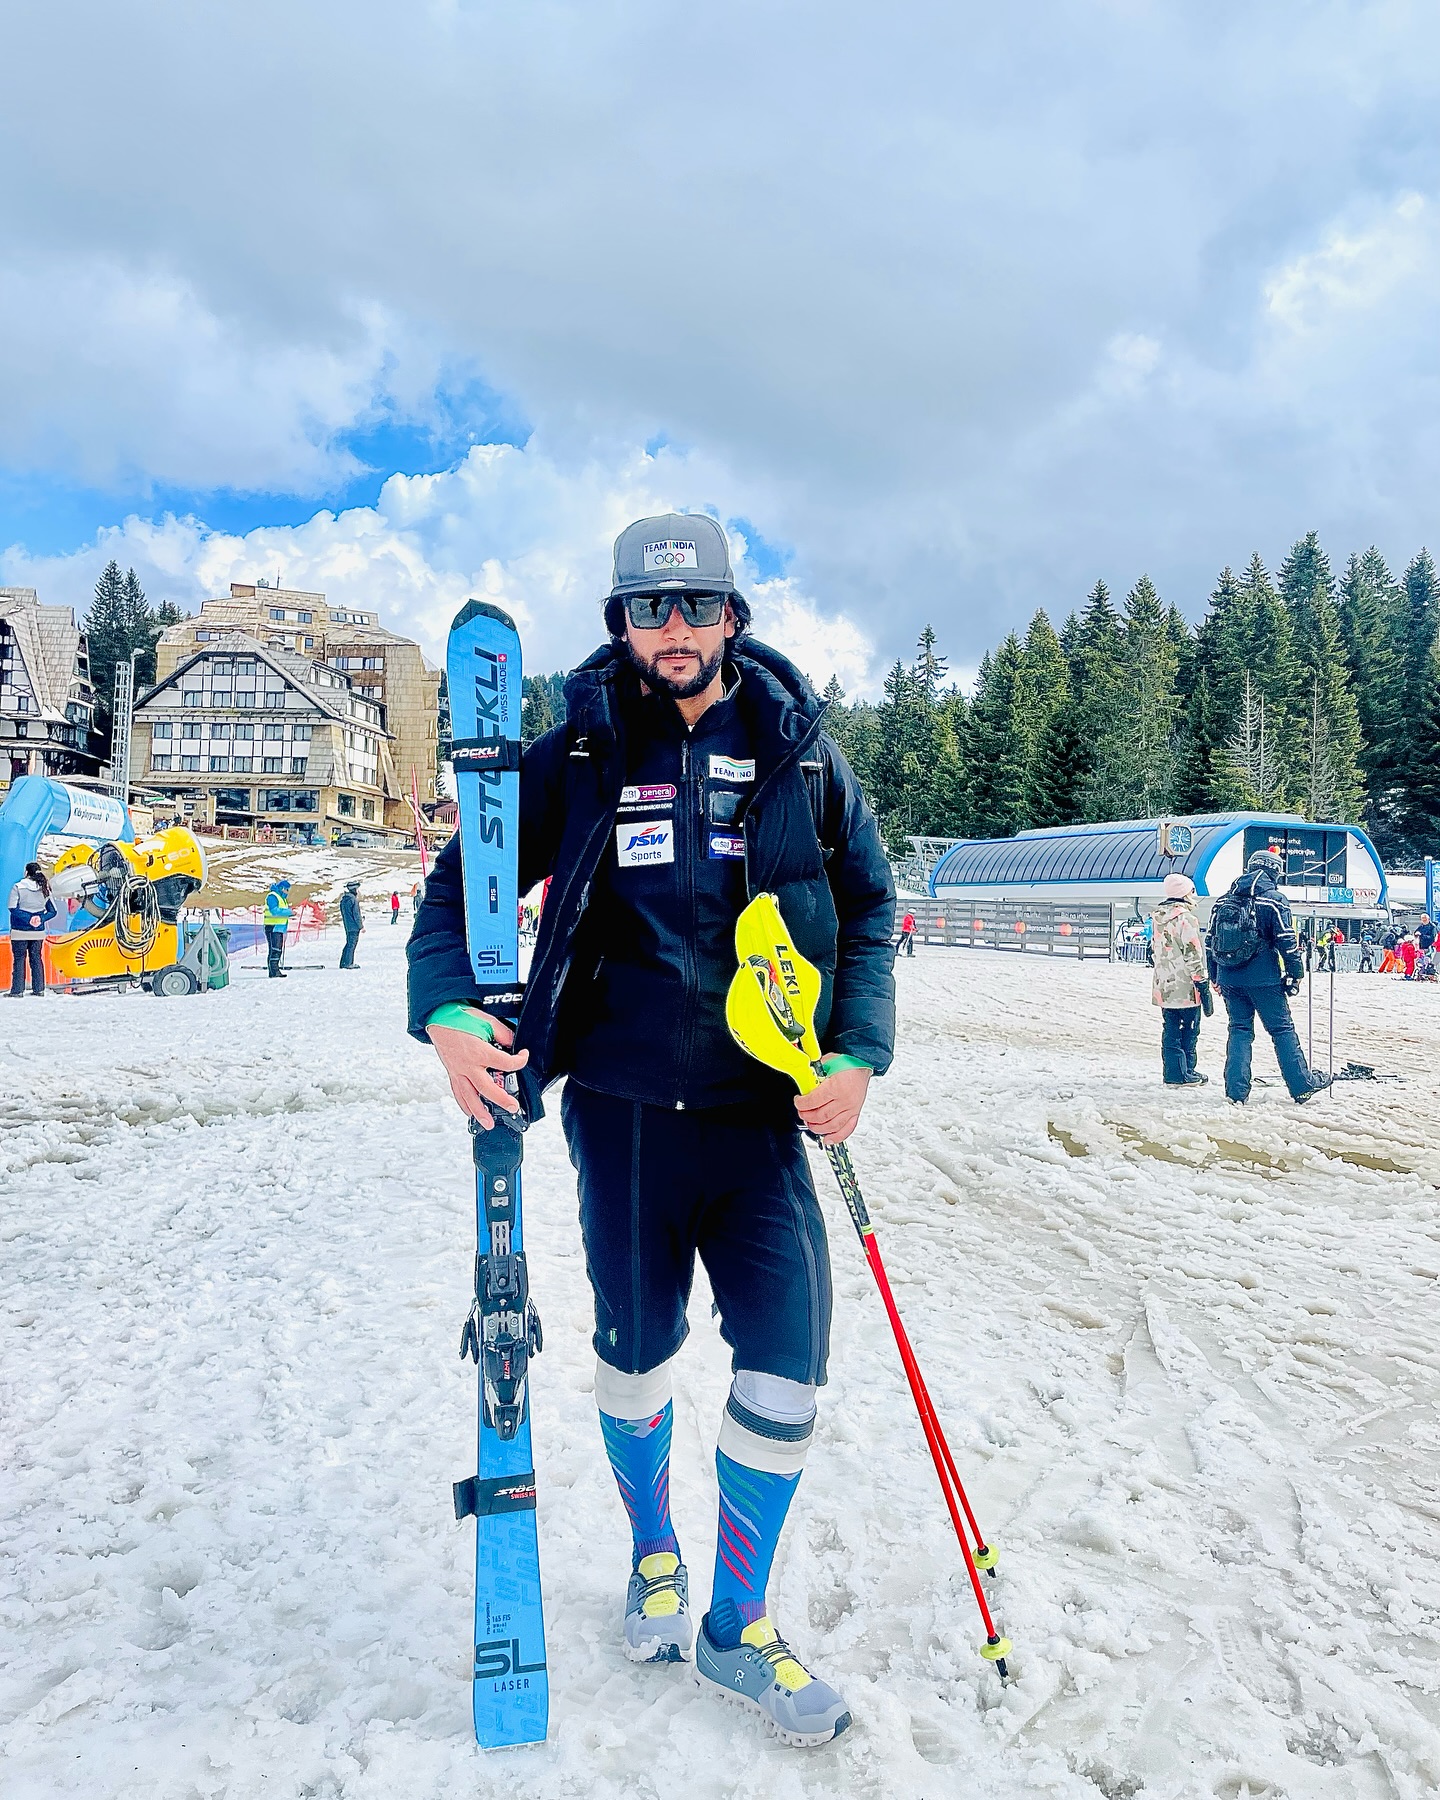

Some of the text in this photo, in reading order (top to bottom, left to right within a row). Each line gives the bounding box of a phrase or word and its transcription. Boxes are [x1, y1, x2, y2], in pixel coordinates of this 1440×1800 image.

[644, 541, 695, 553] TEAM INDIA
[499, 663, 509, 723] SWISS MADE
[452, 746, 500, 759] TÖCKLI
[713, 767, 735, 778] TEAM
[622, 786, 673, 798] SBI general
[622, 833, 669, 852] JSW
[631, 851, 662, 862] Sports
[477, 950, 514, 967] SL
[774, 945, 801, 996] LEKI
[510, 1491, 529, 1500] SWISS
[475, 1638, 546, 1680] SL
[494, 1678, 530, 1693] LASER
